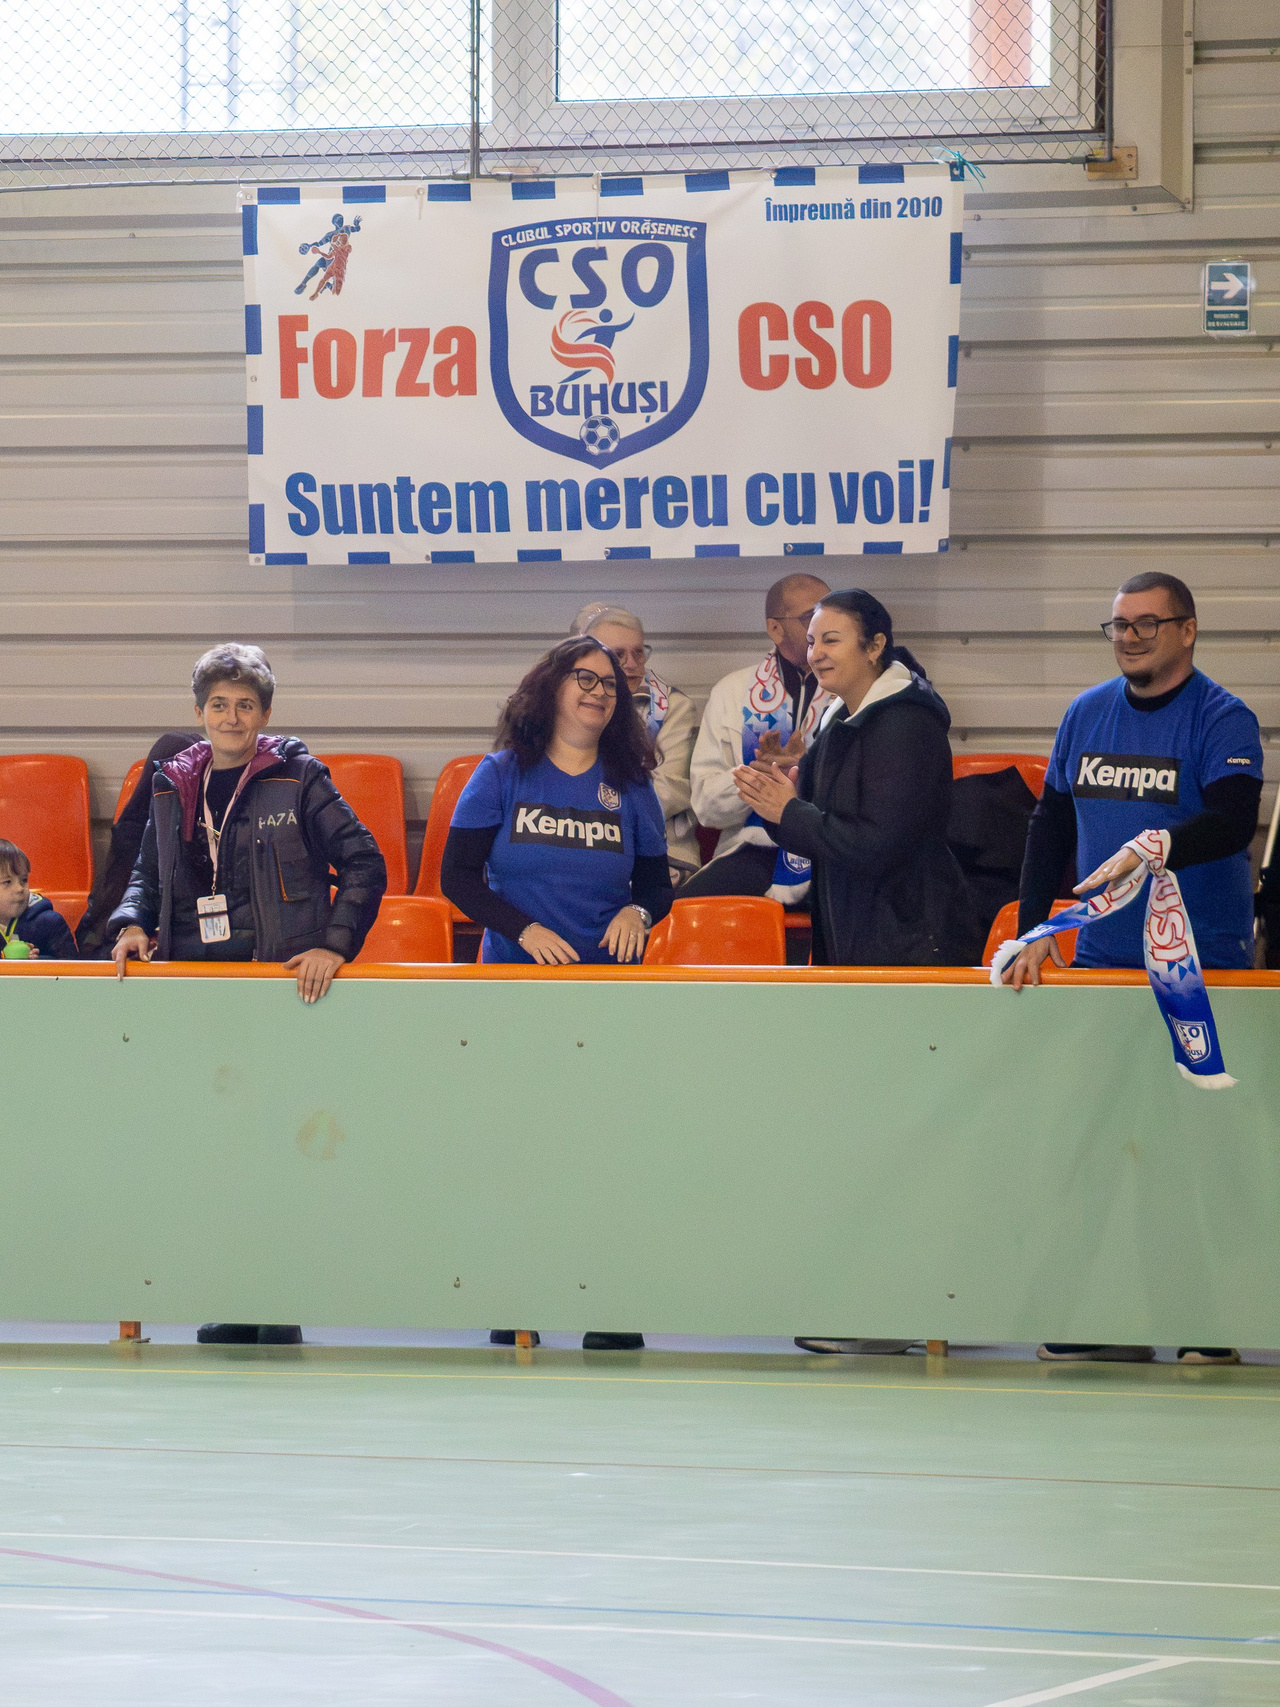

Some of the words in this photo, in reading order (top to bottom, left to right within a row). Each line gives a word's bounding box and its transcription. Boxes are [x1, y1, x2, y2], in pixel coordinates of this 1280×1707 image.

[501, 226, 552, 248] CLUBUL
[555, 220, 616, 237] SPORTIV
[620, 218, 698, 239] ORĂȘENESC
[764, 196, 855, 223] Împreună
[859, 198, 892, 219] din
[896, 196, 943, 218] 2010
[518, 242, 675, 310] CSO
[277, 314, 478, 400] Forza
[737, 299, 892, 391] CSO
[284, 472, 511, 536] Suntem
[525, 474, 729, 533] mereu
[745, 472, 816, 527] cu
[828, 459, 935, 525] voi!
[1076, 756, 1178, 797] Kempa
[515, 807, 621, 847] Kempa
